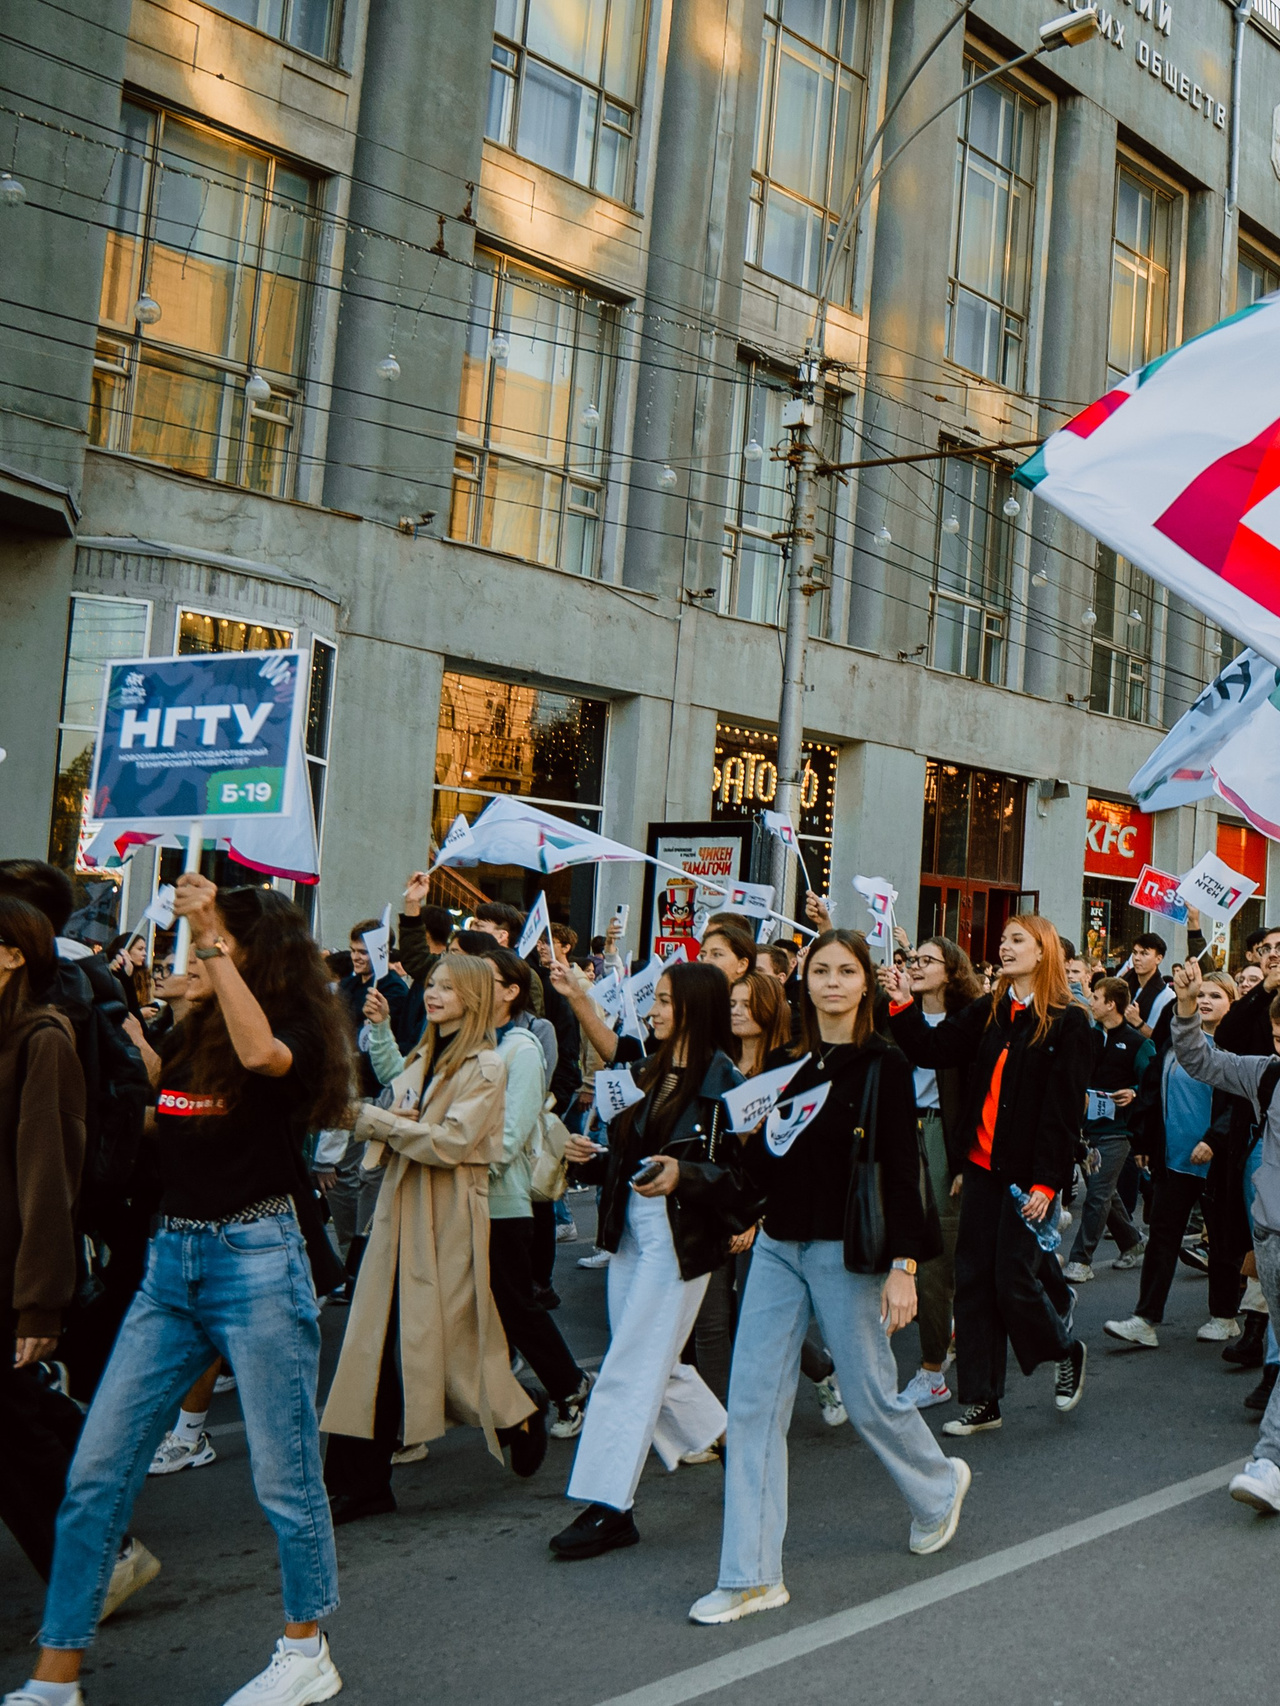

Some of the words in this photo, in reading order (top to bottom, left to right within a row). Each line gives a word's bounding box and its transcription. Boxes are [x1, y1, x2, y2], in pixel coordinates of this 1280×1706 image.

[1136, 40, 1227, 129] ОБЩЕСТВ
[119, 702, 275, 748] НГТУ
[220, 782, 273, 803] Б-19
[1086, 819, 1137, 858] KFC
[698, 847, 733, 861] ЧИКЕН
[682, 861, 733, 875] ТАМАГОЧИ
[1144, 881, 1186, 907] П-35
[1091, 907, 1103, 917] KFC
